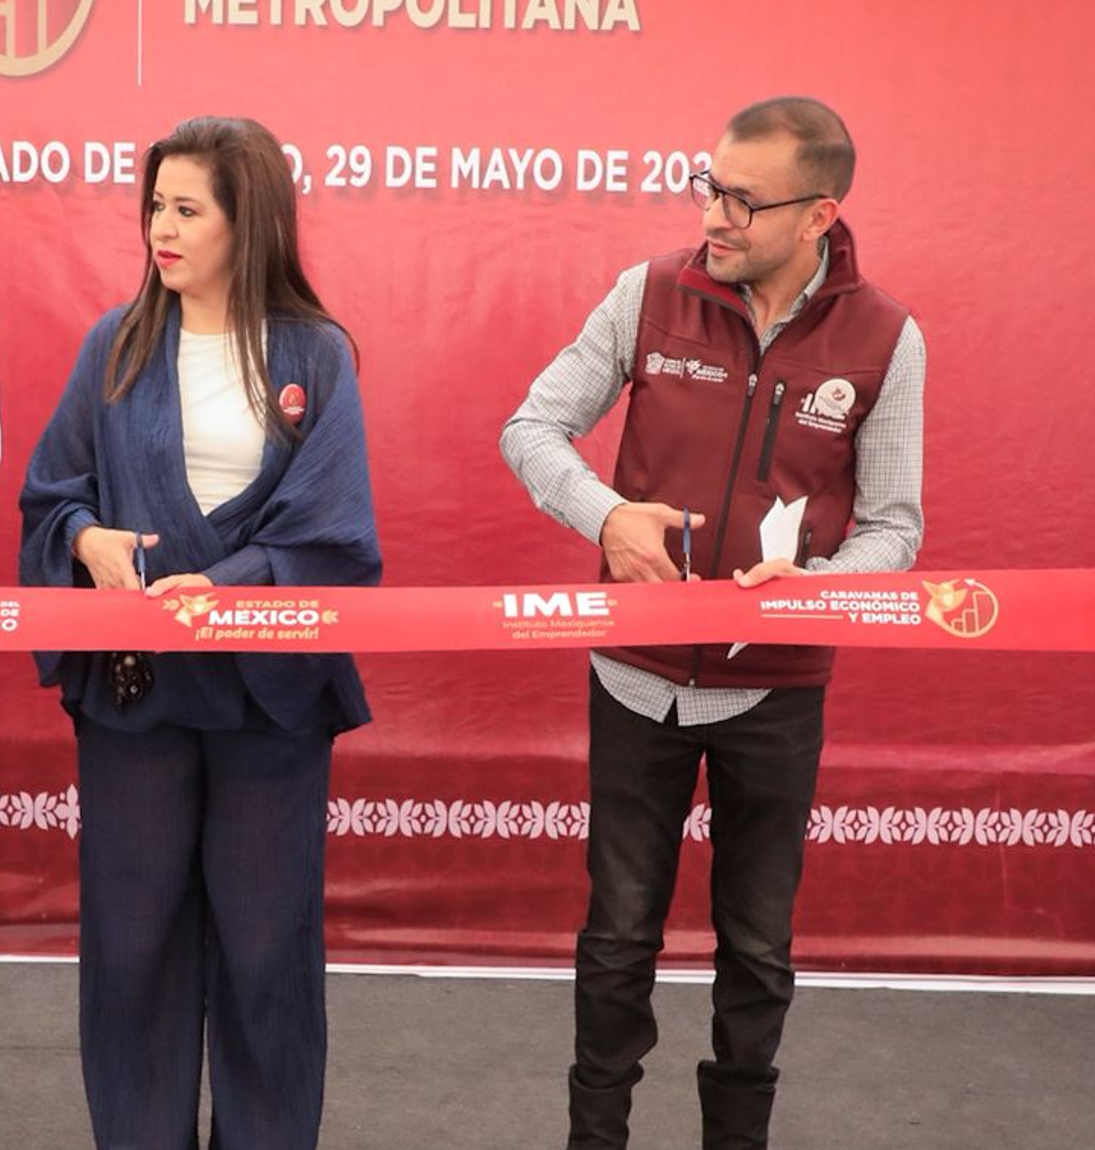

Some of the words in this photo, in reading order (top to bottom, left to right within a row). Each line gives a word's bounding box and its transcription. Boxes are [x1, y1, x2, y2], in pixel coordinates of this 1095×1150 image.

[183, 0, 641, 31] METROPOLITANA
[84, 142, 136, 185] DE
[324, 145, 372, 187] 29
[385, 147, 438, 189] DE
[450, 148, 563, 191] MAYO
[576, 151, 629, 193] DE
[641, 150, 712, 193] 202
[820, 590, 898, 600] CARAVANAS
[900, 591, 919, 601] DE
[235, 600, 297, 608] ESTADO
[298, 600, 319, 608] DE
[503, 591, 610, 617] IME
[760, 600, 827, 611] IMPULSO
[0, 608, 20, 617] DE
[848, 612, 858, 623] Y
[861, 613, 922, 625] EMPLEO
[195, 627, 213, 641] ¡El
[215, 627, 256, 641] poder
[257, 627, 274, 640] de
[277, 626, 320, 640] servir!
[512, 630, 529, 640] del
[531, 629, 607, 640] Emprendedor
